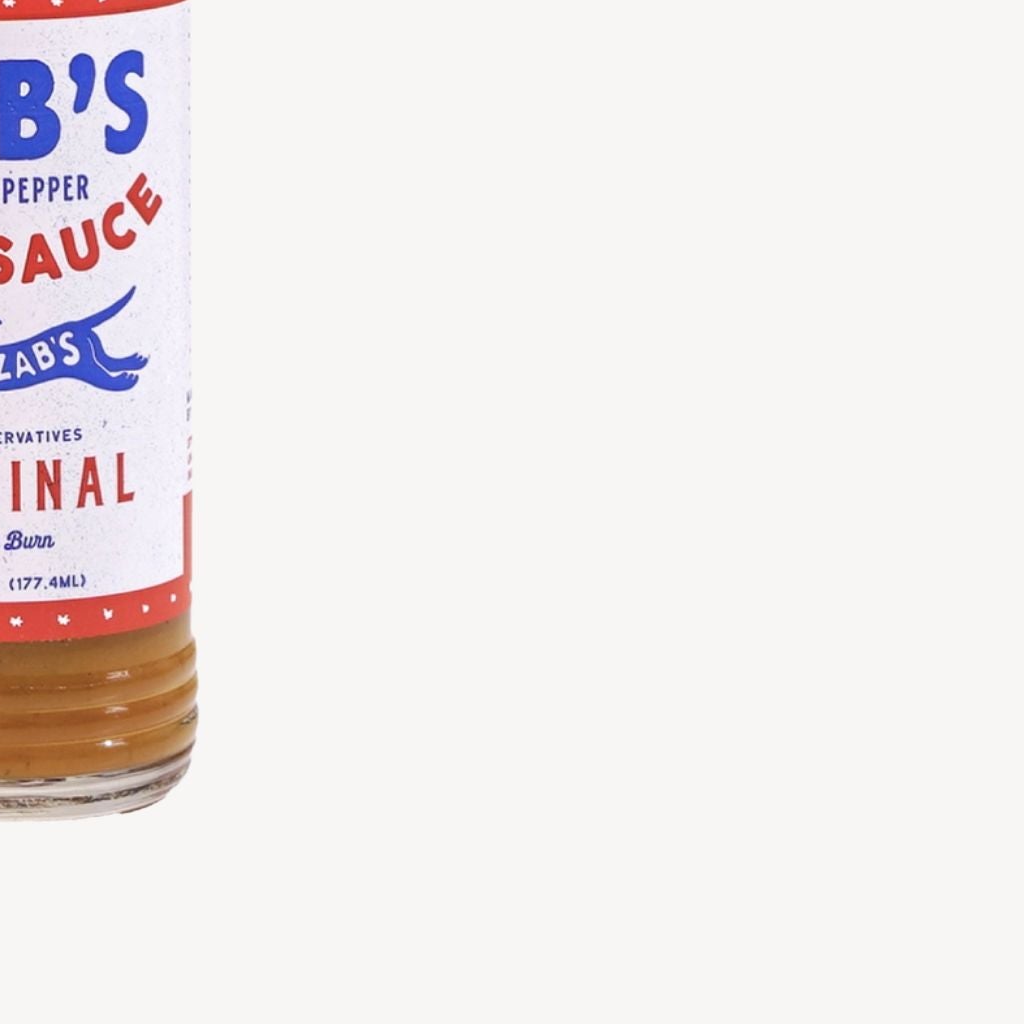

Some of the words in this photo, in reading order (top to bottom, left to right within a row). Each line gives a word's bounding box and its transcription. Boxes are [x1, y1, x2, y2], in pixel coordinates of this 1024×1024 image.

[3, 174, 89, 204] PEPPER
[4, 530, 55, 551] Burn
[9, 574, 87, 592] (177.4ML)
